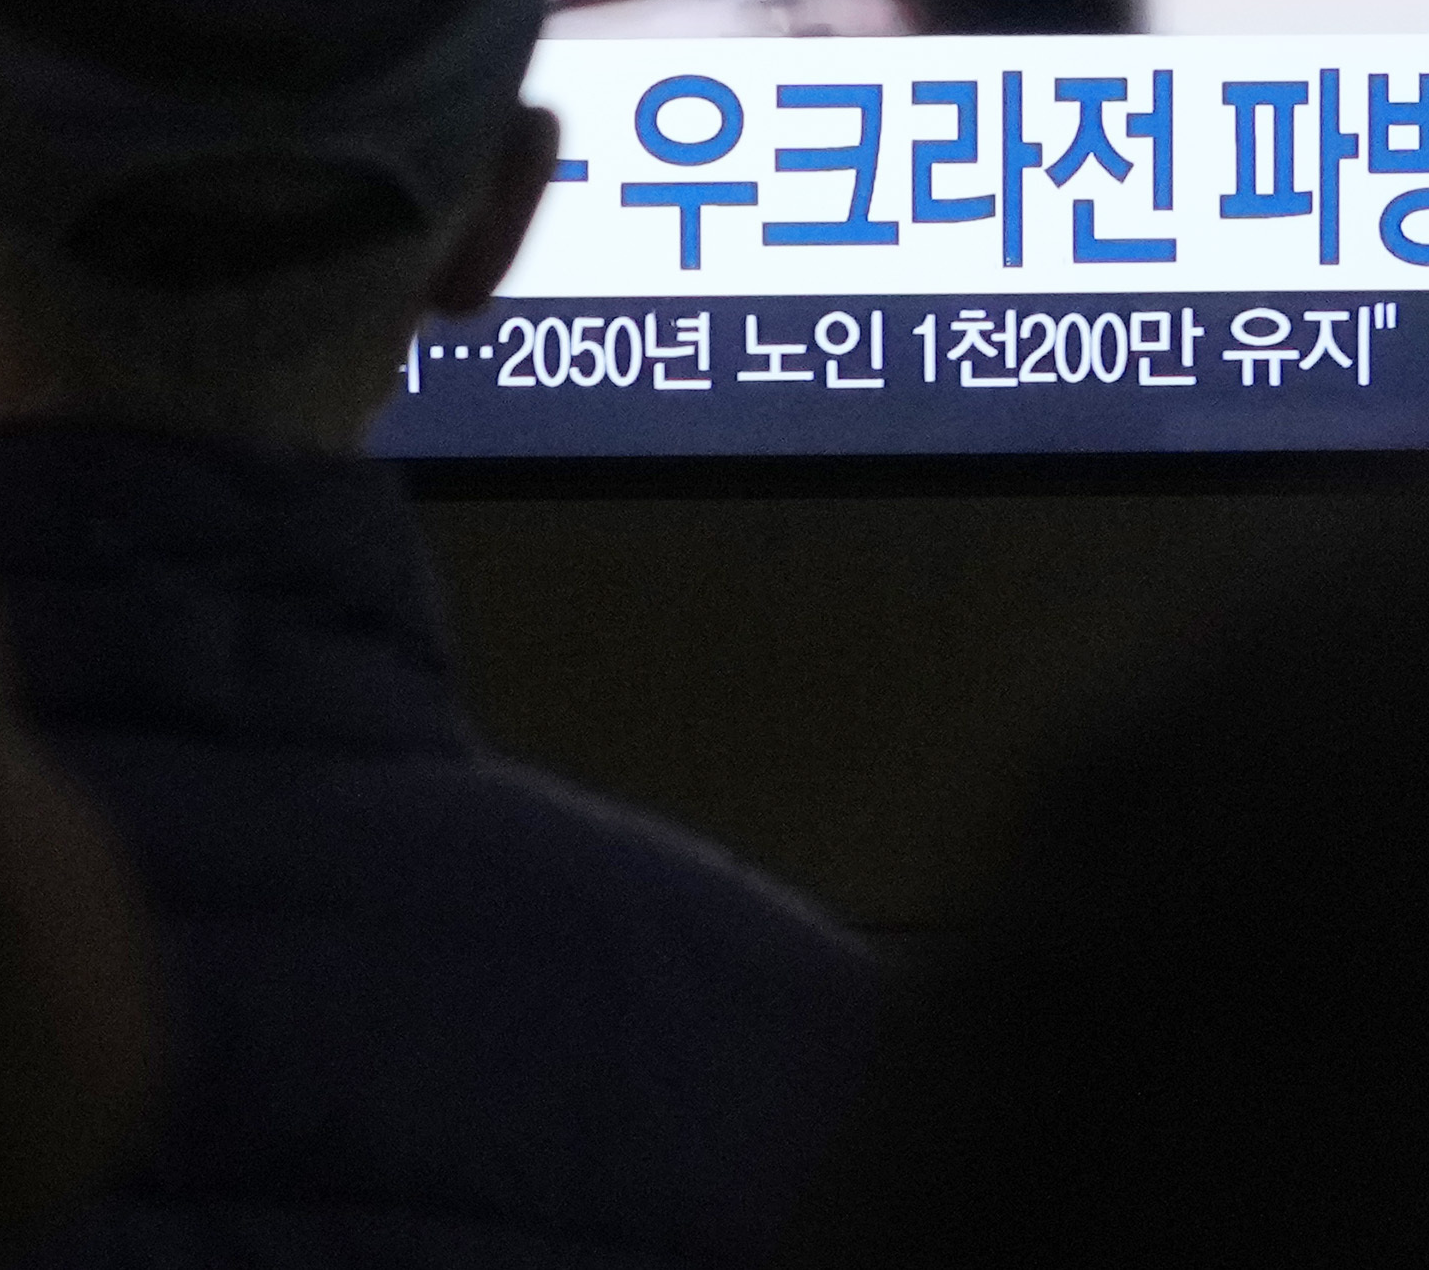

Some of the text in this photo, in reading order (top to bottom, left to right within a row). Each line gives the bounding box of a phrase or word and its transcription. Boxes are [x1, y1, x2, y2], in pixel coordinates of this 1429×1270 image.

[620, 70, 1178, 270] 우크라전
[735, 309, 886, 390] 노인
[911, 307, 1206, 389] 1천200만
